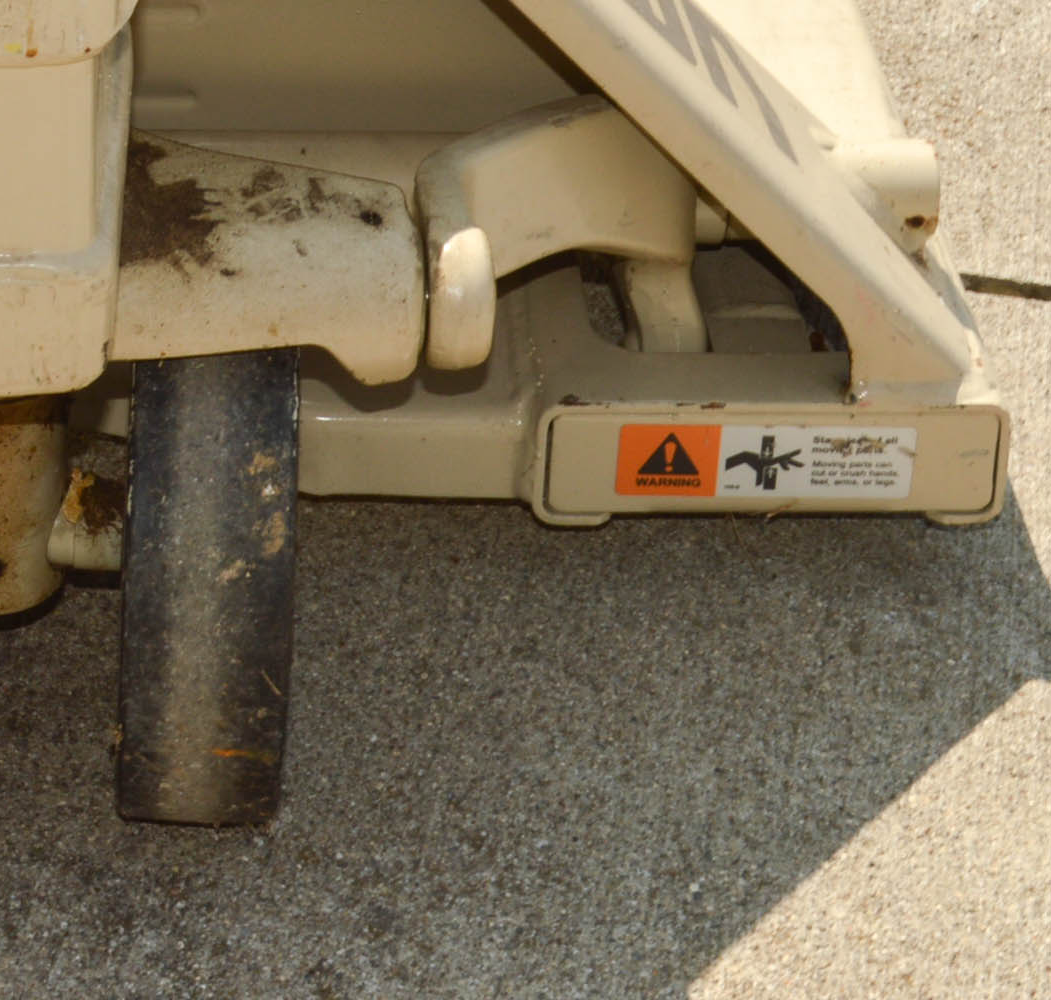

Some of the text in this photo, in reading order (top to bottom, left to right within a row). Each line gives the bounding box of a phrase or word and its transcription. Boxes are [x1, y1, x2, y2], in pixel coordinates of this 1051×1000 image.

[813, 436, 837, 445] Sta
[885, 436, 898, 444] all
[812, 459, 846, 469] Moving
[636, 477, 701, 488] WARNING
